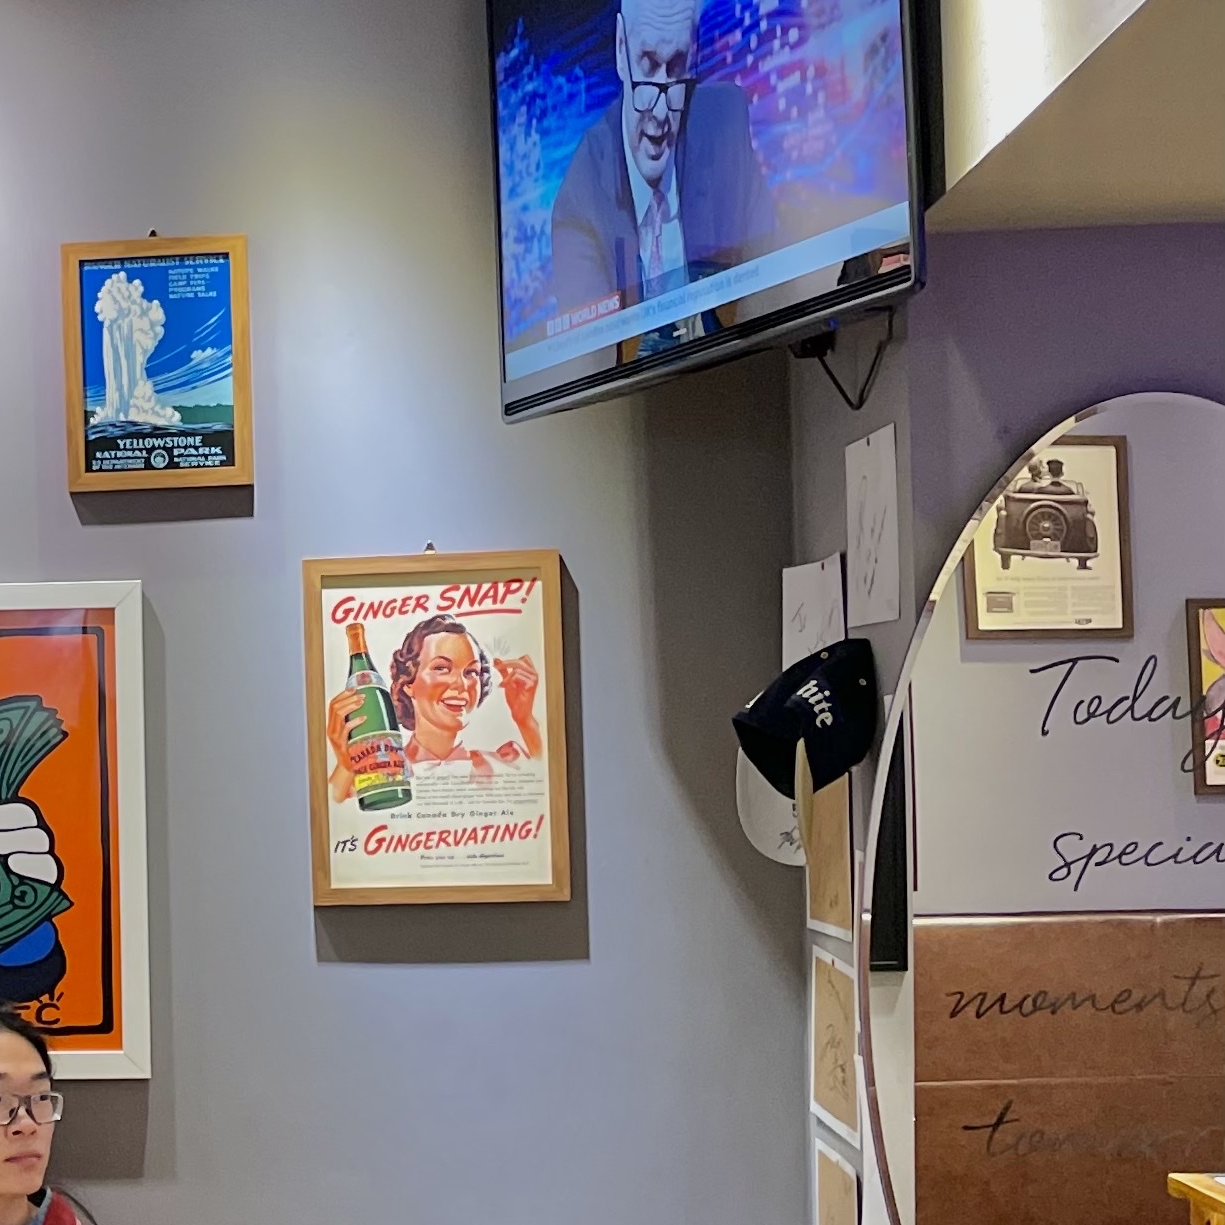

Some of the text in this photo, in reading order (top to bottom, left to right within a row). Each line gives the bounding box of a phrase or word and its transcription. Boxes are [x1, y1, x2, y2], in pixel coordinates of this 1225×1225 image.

[570, 305, 597, 327] WORLD
[598, 295, 621, 316] NEWS
[96, 446, 223, 458] NATIONAL PARK
[117, 436, 203, 449] YELLOWSTONE
[330, 577, 538, 625] GINGER SNAP!
[334, 814, 545, 856] IT'S GINGERVATING!
[1048, 832, 1225, 891] Specia
[945, 962, 1225, 1027] moments
